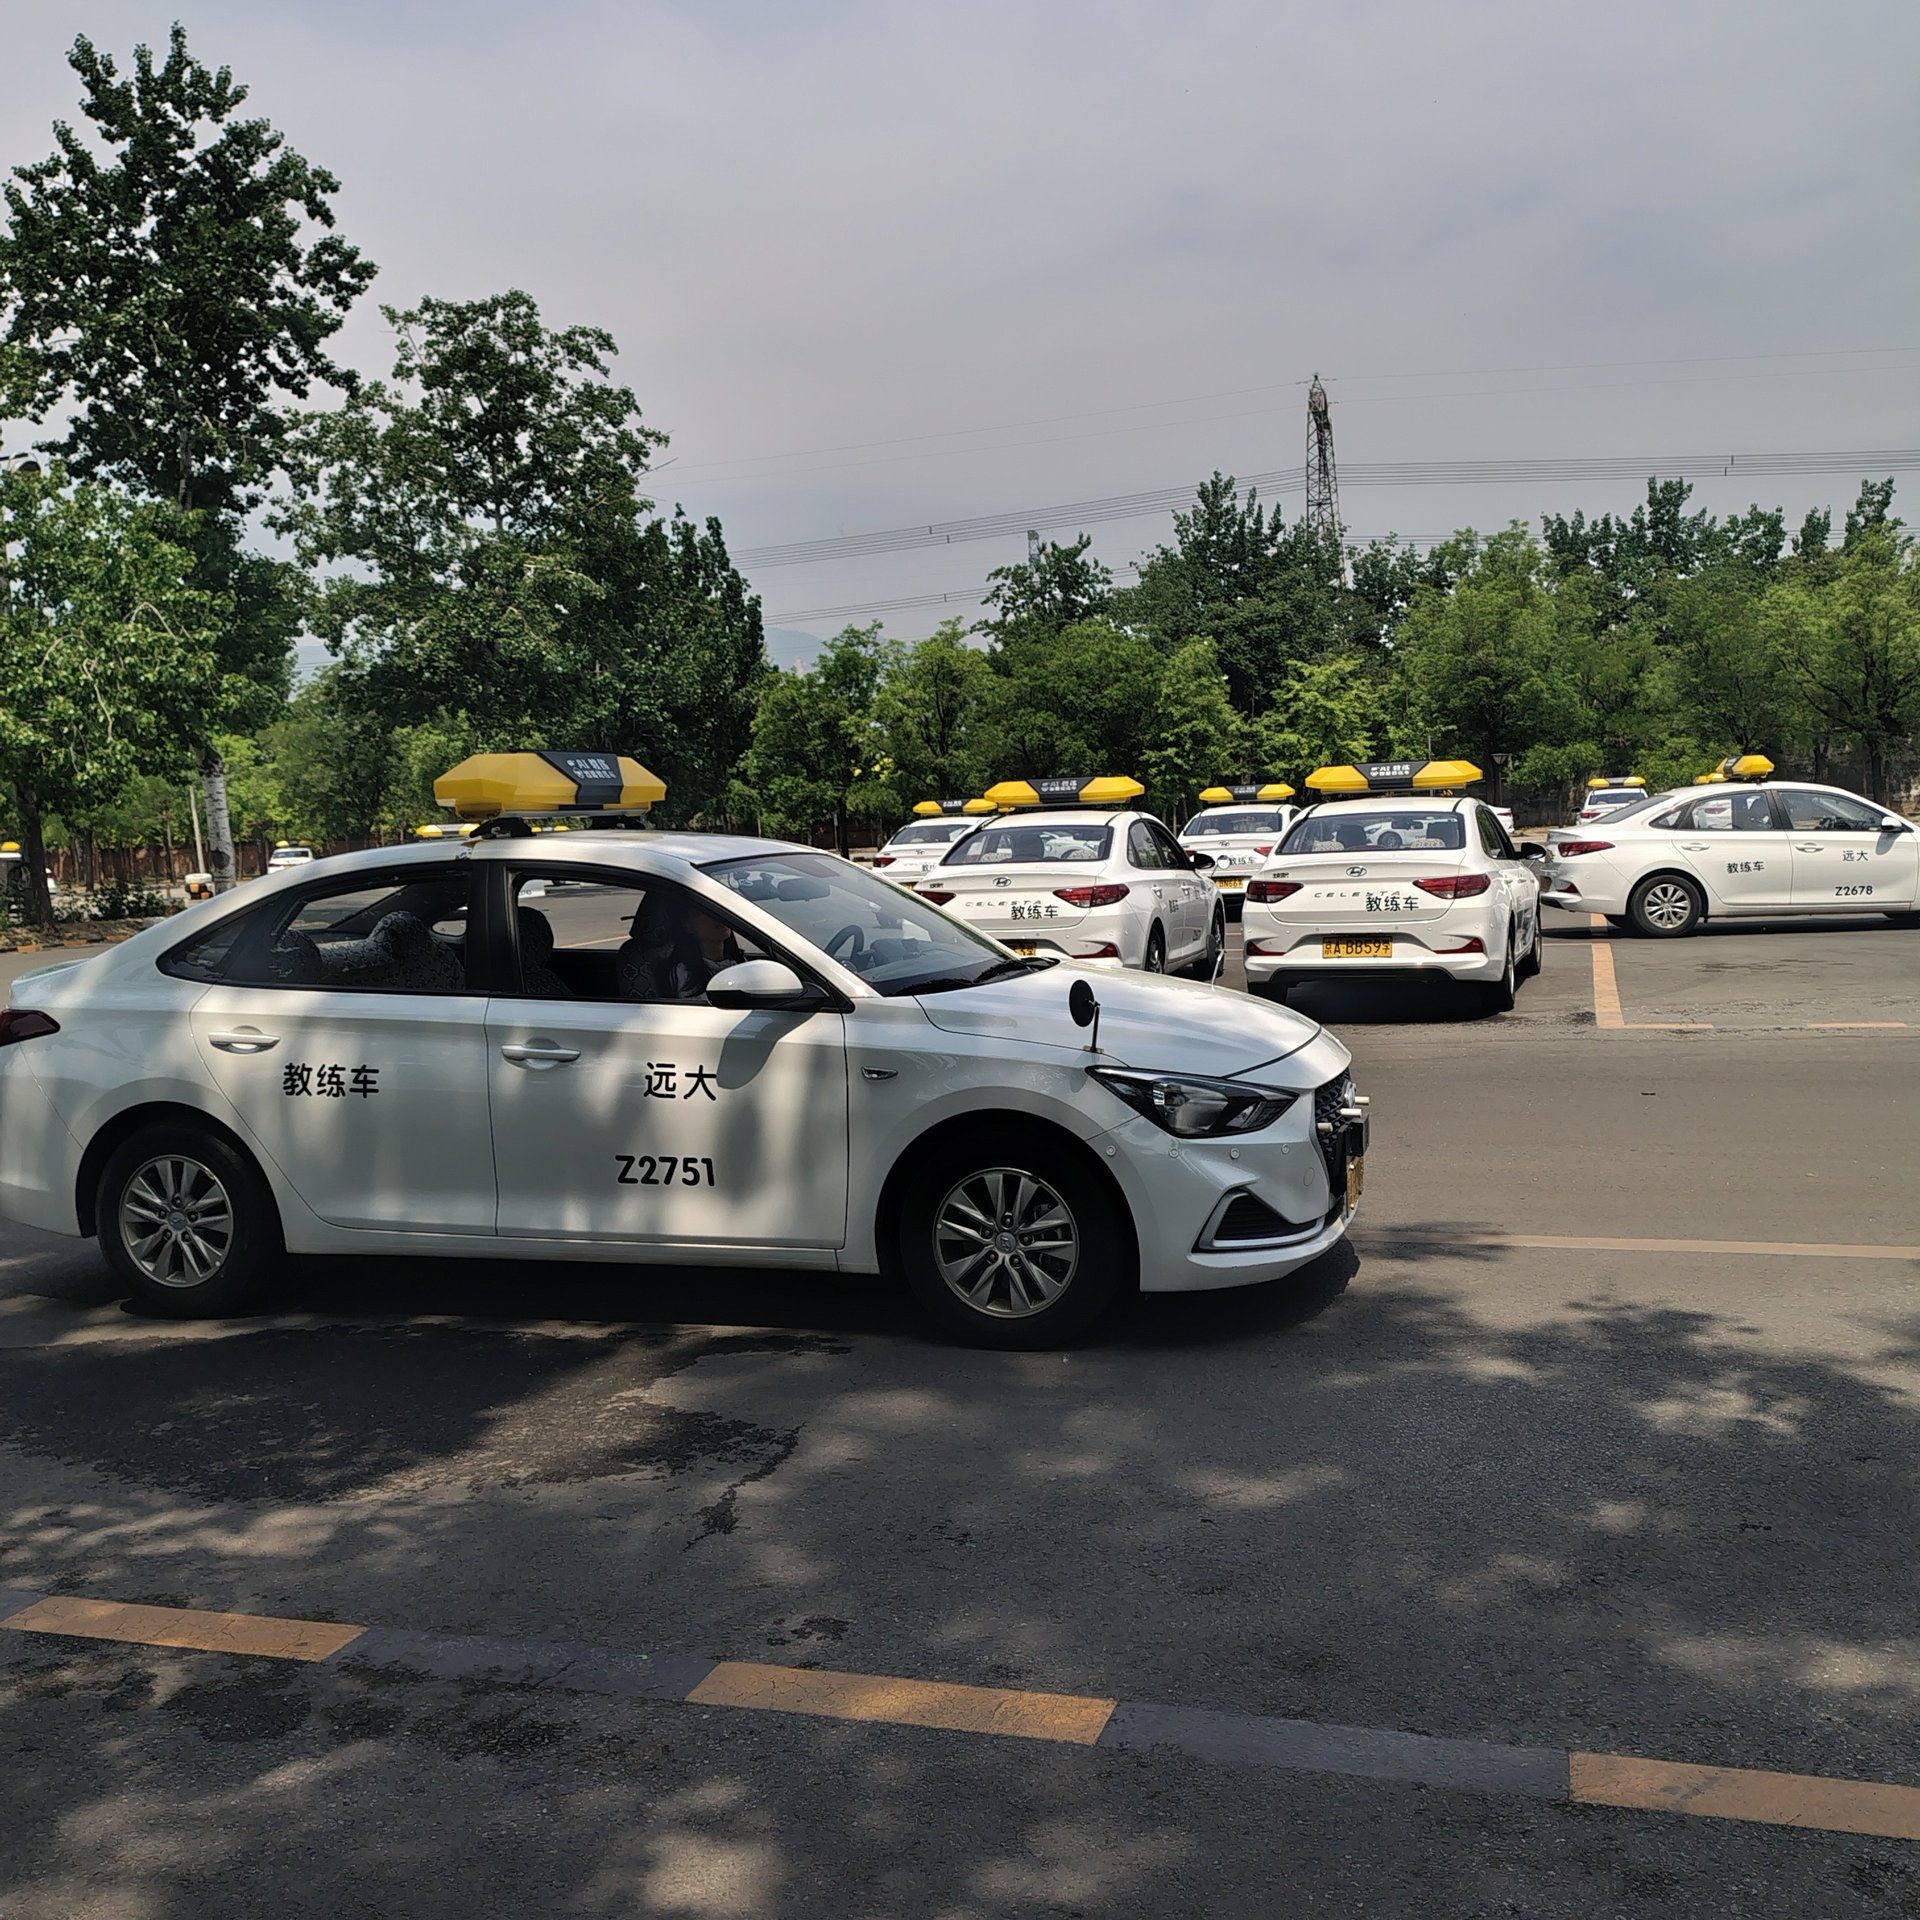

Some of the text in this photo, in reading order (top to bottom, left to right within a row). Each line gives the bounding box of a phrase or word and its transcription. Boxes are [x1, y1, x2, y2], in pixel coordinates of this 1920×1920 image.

[1843, 850, 1869, 862] 远大
[1727, 861, 1765, 874] 教练车
[1835, 885, 1873, 896] Z2678
[1366, 896, 1419, 912] 教练车
[1011, 905, 1059, 920] 教练车
[283, 1063, 379, 1098] 教练车
[644, 1062, 717, 1101] 远大
[615, 1155, 715, 1186] Z2751
